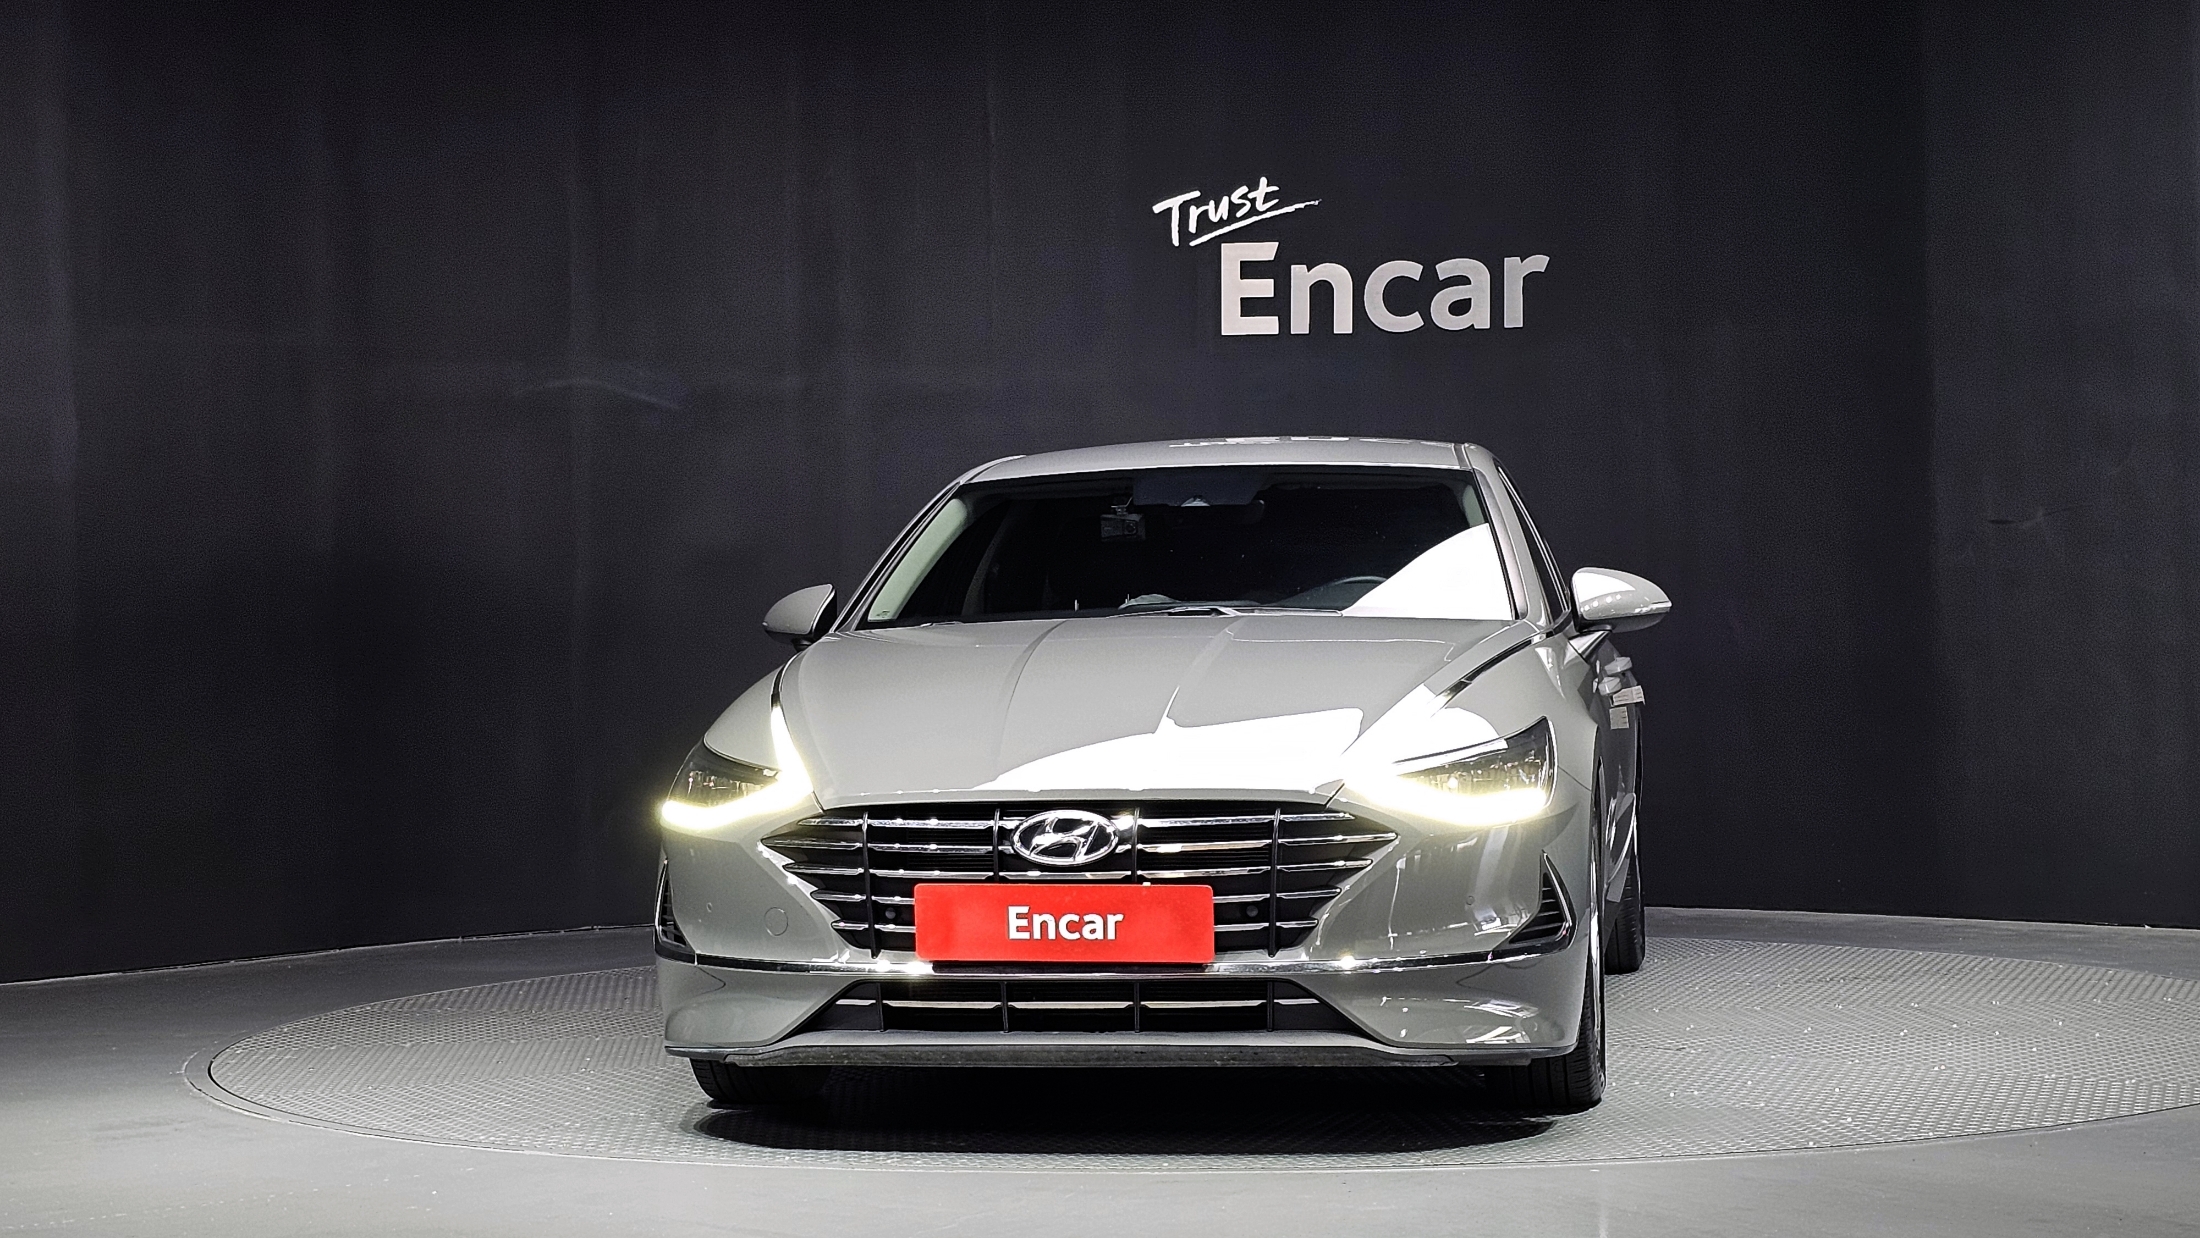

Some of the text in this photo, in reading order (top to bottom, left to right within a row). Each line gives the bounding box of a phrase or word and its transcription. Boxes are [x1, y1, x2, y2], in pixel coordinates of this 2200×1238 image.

[1152, 176, 1280, 247] Trust
[1220, 241, 1550, 336] Encar
[1007, 905, 1125, 941] Encar
